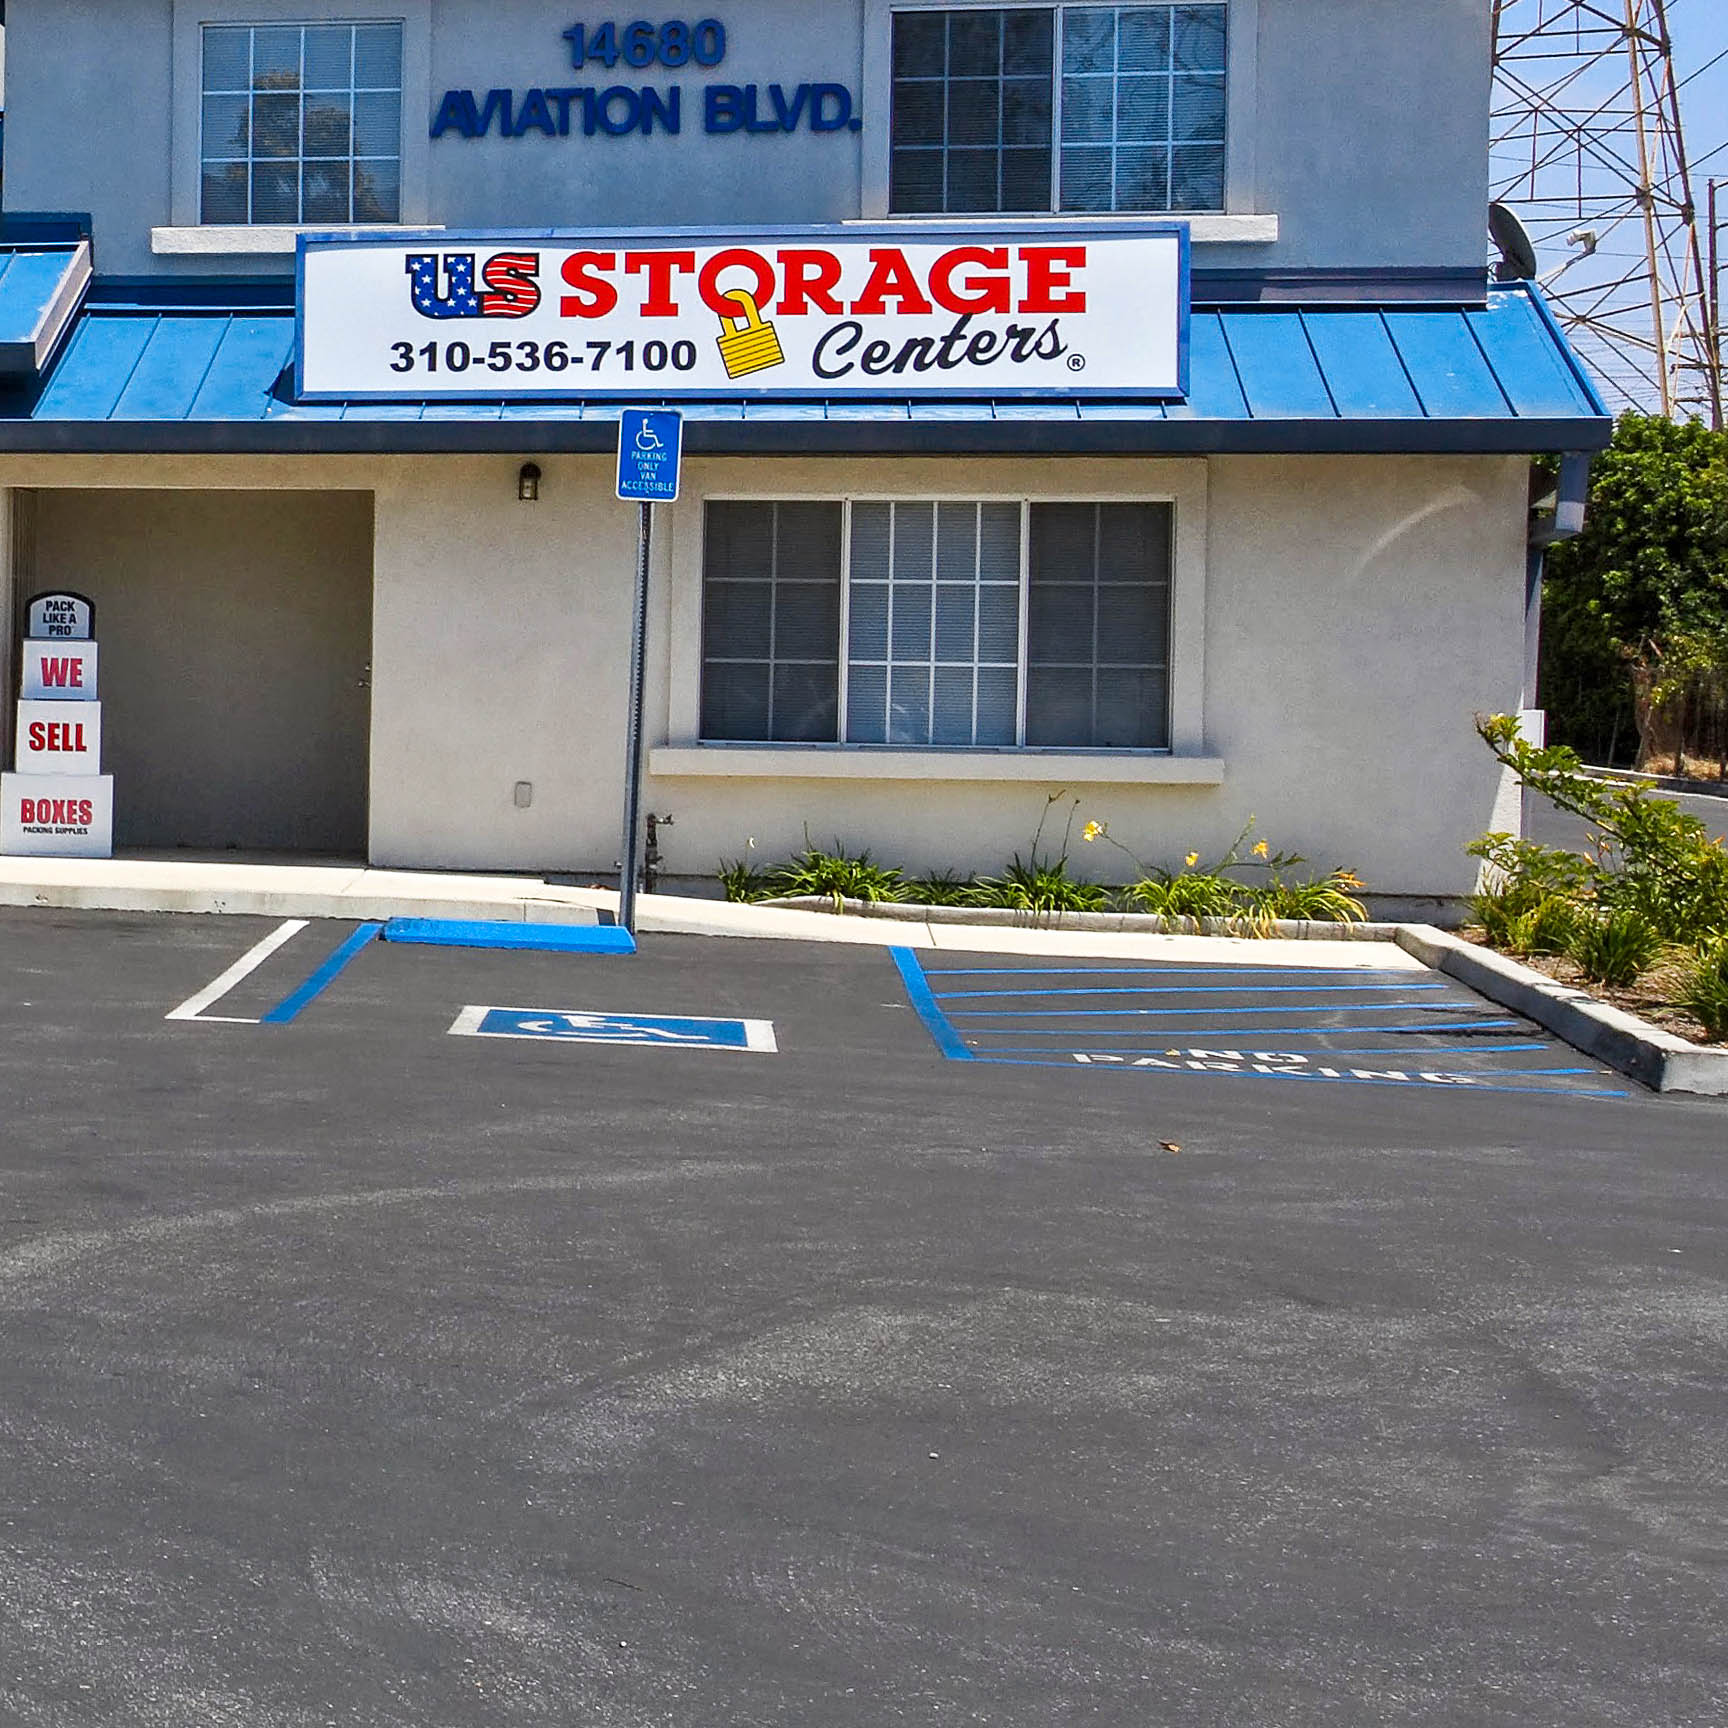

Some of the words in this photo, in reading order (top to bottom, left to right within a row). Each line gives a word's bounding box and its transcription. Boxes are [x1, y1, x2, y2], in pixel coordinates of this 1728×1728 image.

[561, 18, 727, 70] 14680
[429, 85, 681, 138] AVIATION
[704, 83, 862, 134] BLVD.
[405, 252, 542, 320] US
[560, 246, 1087, 318] STORAGE
[389, 339, 697, 372] 310-536-7100
[811, 312, 1070, 380] Centers
[631, 450, 668, 462] PARKING
[637, 461, 660, 471] ONLY
[621, 480, 674, 492] ACCESSIBLE
[639, 471, 657, 481] VAN
[45, 600, 76, 612] PACK
[42, 612, 68, 624] LIKE
[68, 613, 77, 624] A
[48, 625, 72, 636] PRO
[40, 657, 83, 687] WE
[28, 721, 88, 752] SELL
[20, 798, 94, 825] BOXES
[22, 826, 53, 835] PACKING
[54, 827, 88, 836] SUPPLIES
[1187, 1048, 1309, 1064] NO
[1072, 1053, 1477, 1085] PARKING
